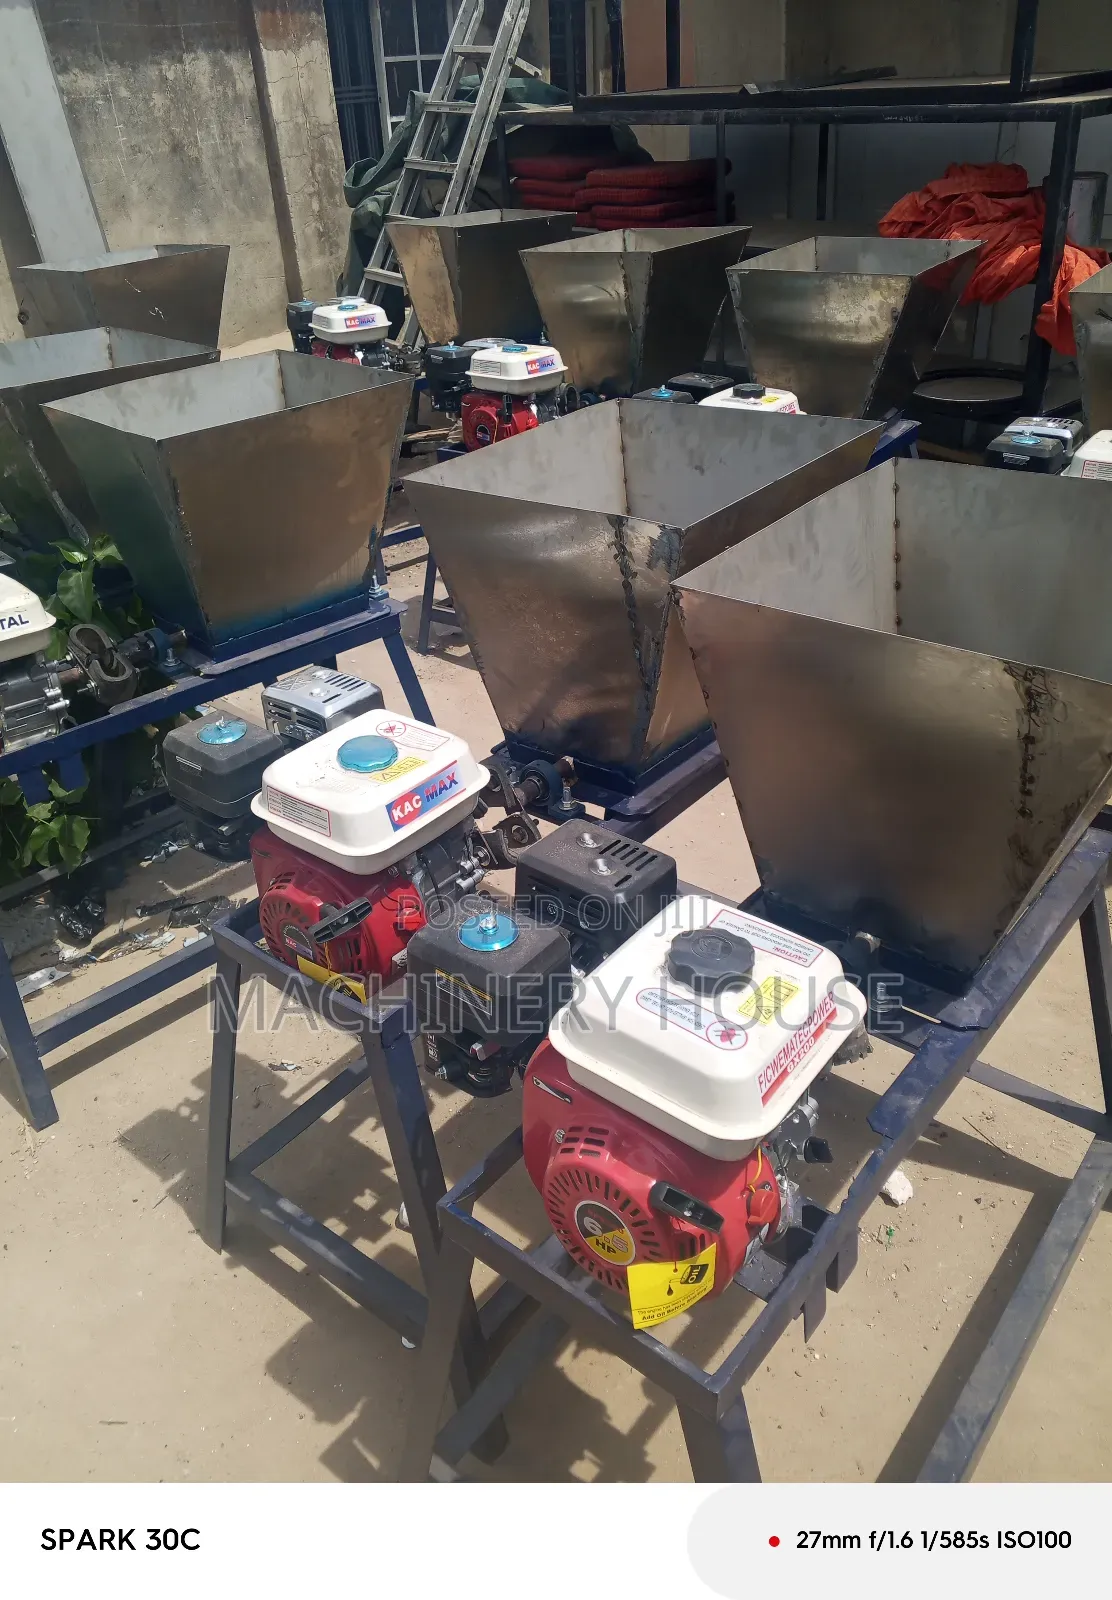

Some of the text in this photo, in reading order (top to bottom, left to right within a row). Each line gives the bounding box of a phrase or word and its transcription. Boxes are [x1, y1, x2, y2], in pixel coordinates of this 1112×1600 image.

[361, 316, 375, 324] MAX
[527, 359, 555, 371] KAC MAX
[391, 772, 458, 821] KAC MAX
[787, 1036, 816, 1074] GX200
[595, 1238, 616, 1254] HP
[688, 1265, 701, 1283] OIL
